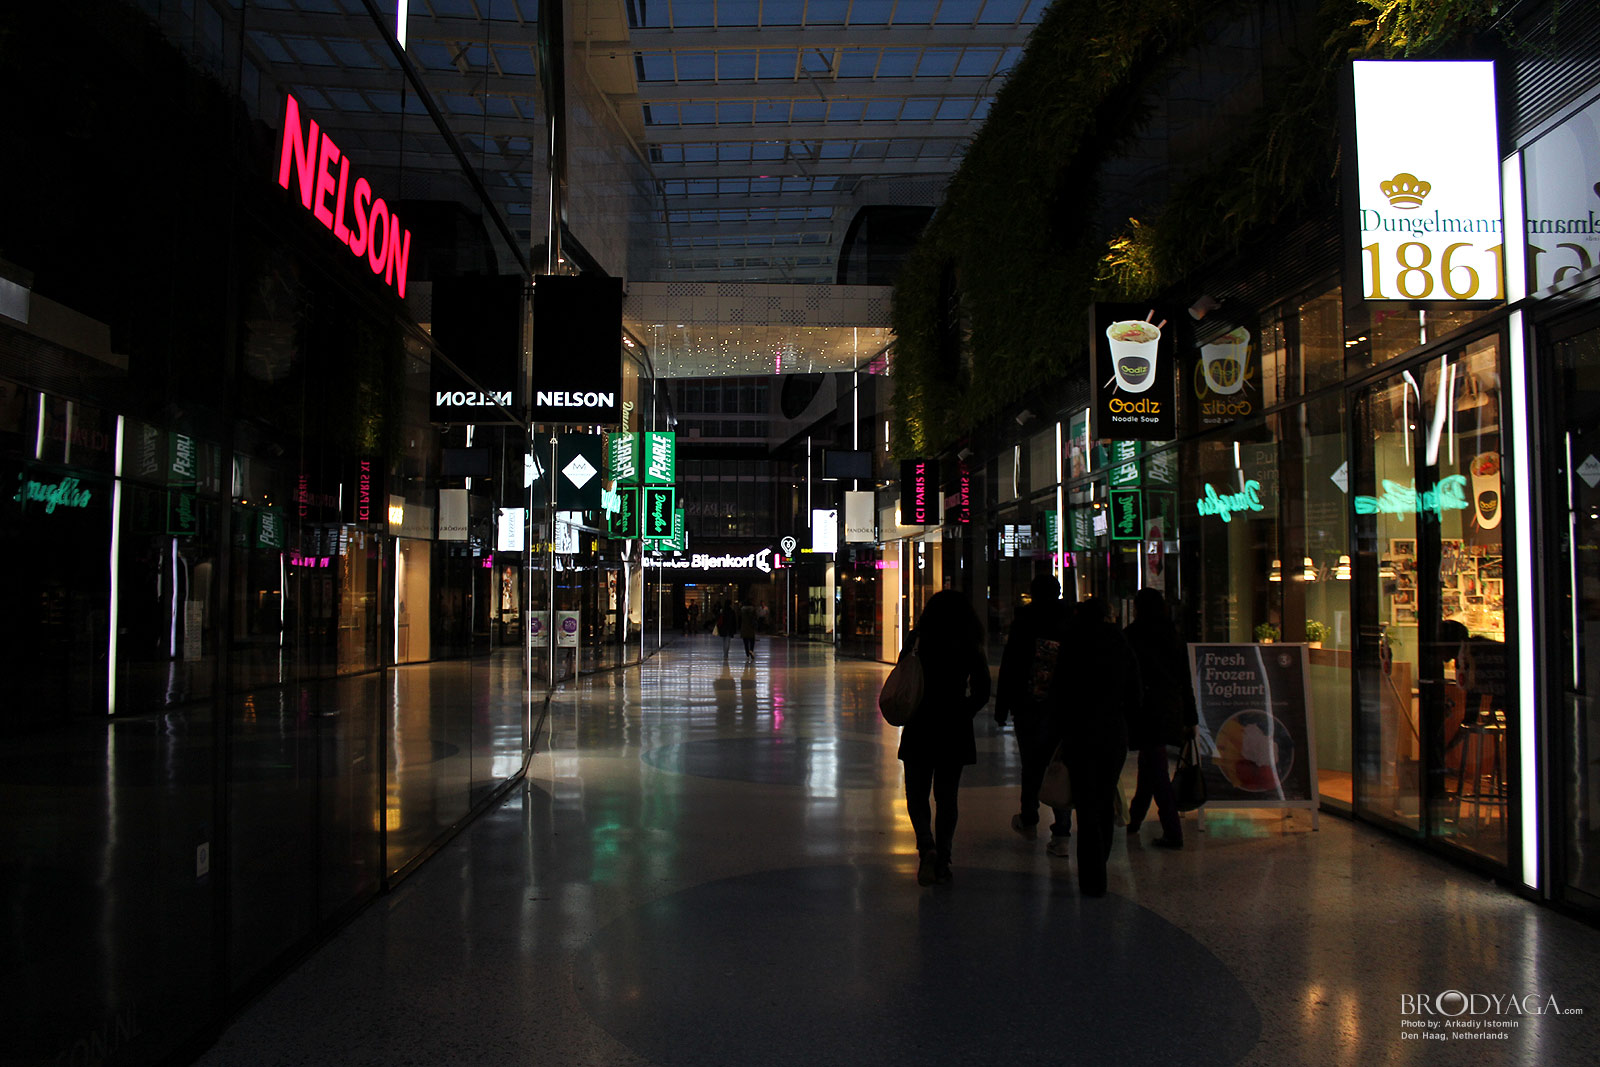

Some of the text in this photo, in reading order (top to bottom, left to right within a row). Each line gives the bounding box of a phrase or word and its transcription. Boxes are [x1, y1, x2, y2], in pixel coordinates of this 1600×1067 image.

[279, 93, 411, 299] NELSON
[1360, 209, 1503, 238] Dungelmann
[1361, 242, 1505, 300] 1861
[536, 391, 614, 408] NELSON
[1108, 398, 1161, 414] Oodlz
[1111, 415, 1160, 424] Noodle Soup
[648, 433, 667, 480] PEARLE
[915, 461, 926, 523] ICI PARIS XL
[691, 553, 755, 571] Bijenkorf
[1204, 653, 1245, 666] Fresh
[1205, 667, 1256, 681] Frozen
[1206, 682, 1265, 698] Yoghurt
